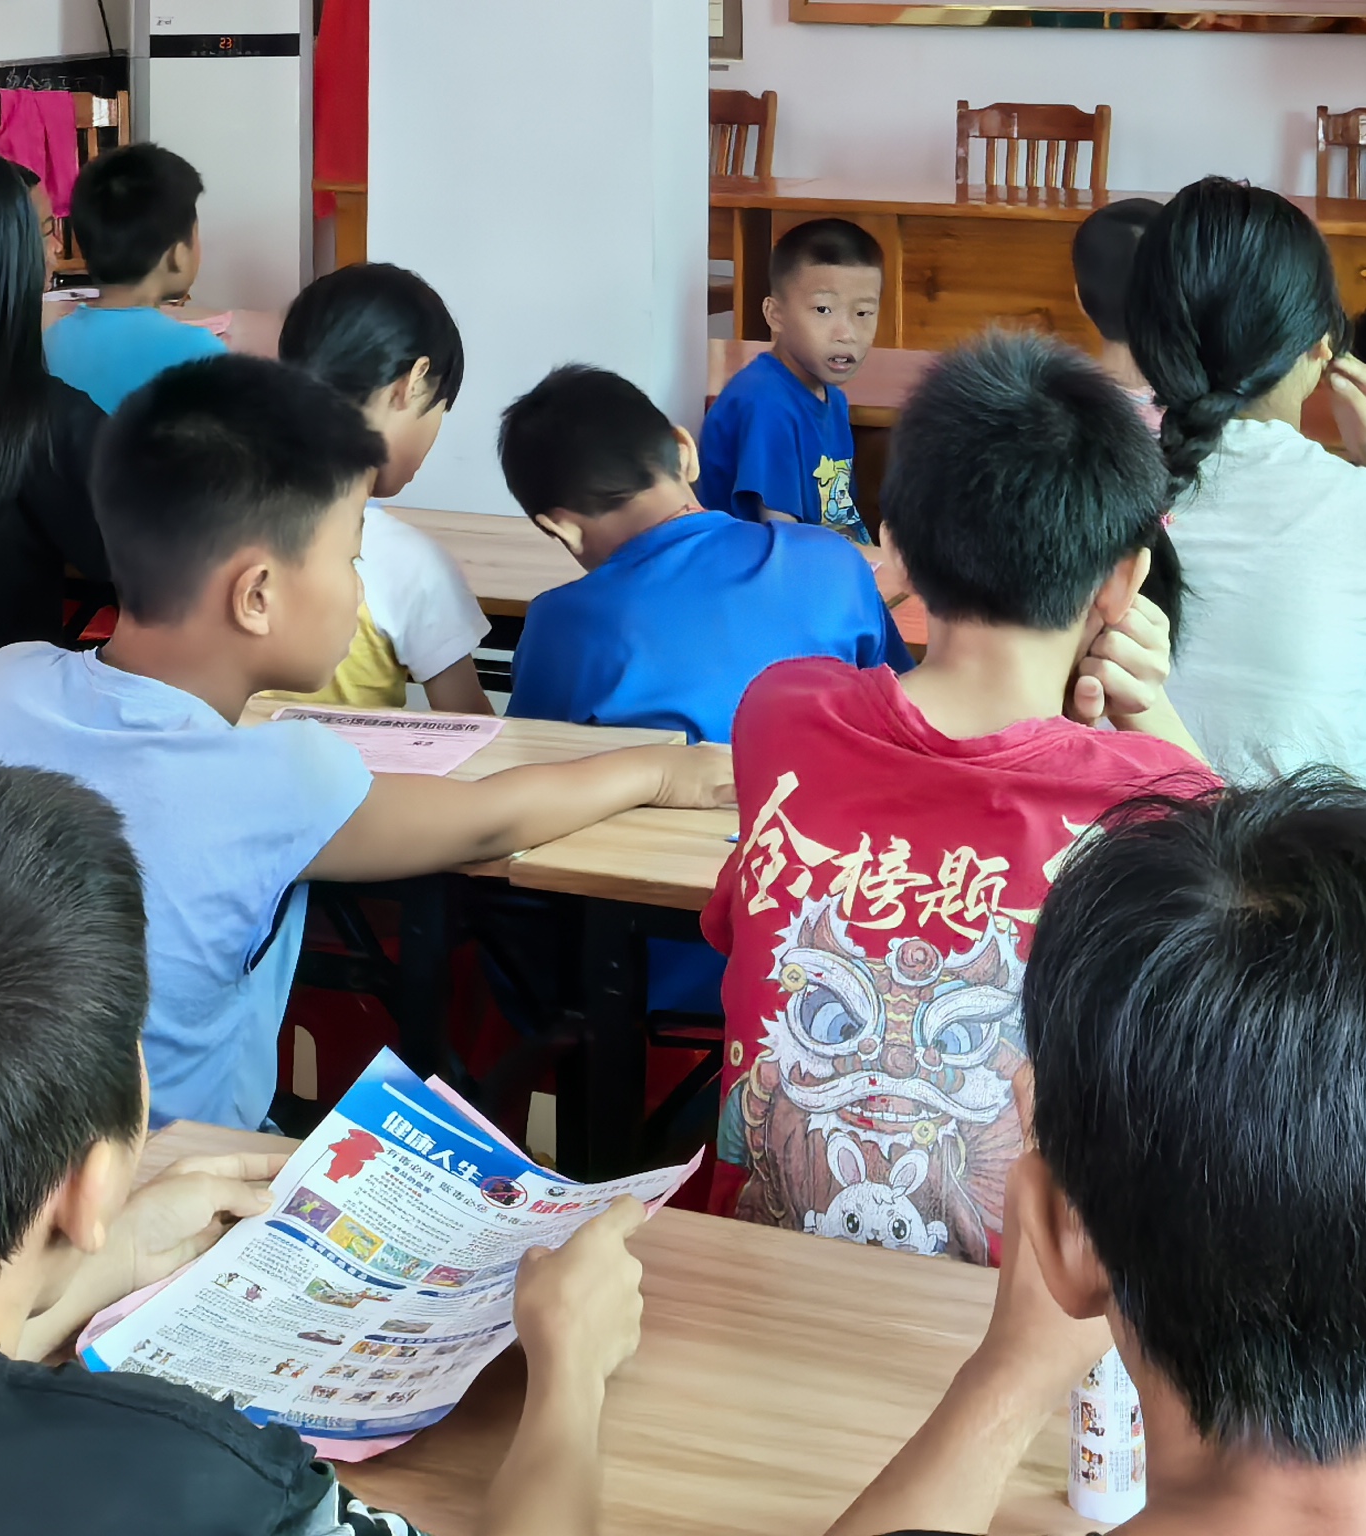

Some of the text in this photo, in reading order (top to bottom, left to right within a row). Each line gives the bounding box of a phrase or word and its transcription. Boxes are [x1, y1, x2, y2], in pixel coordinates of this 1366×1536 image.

[739, 772, 1105, 940] 金榜题
[381, 1110, 484, 1185] 健康人生
